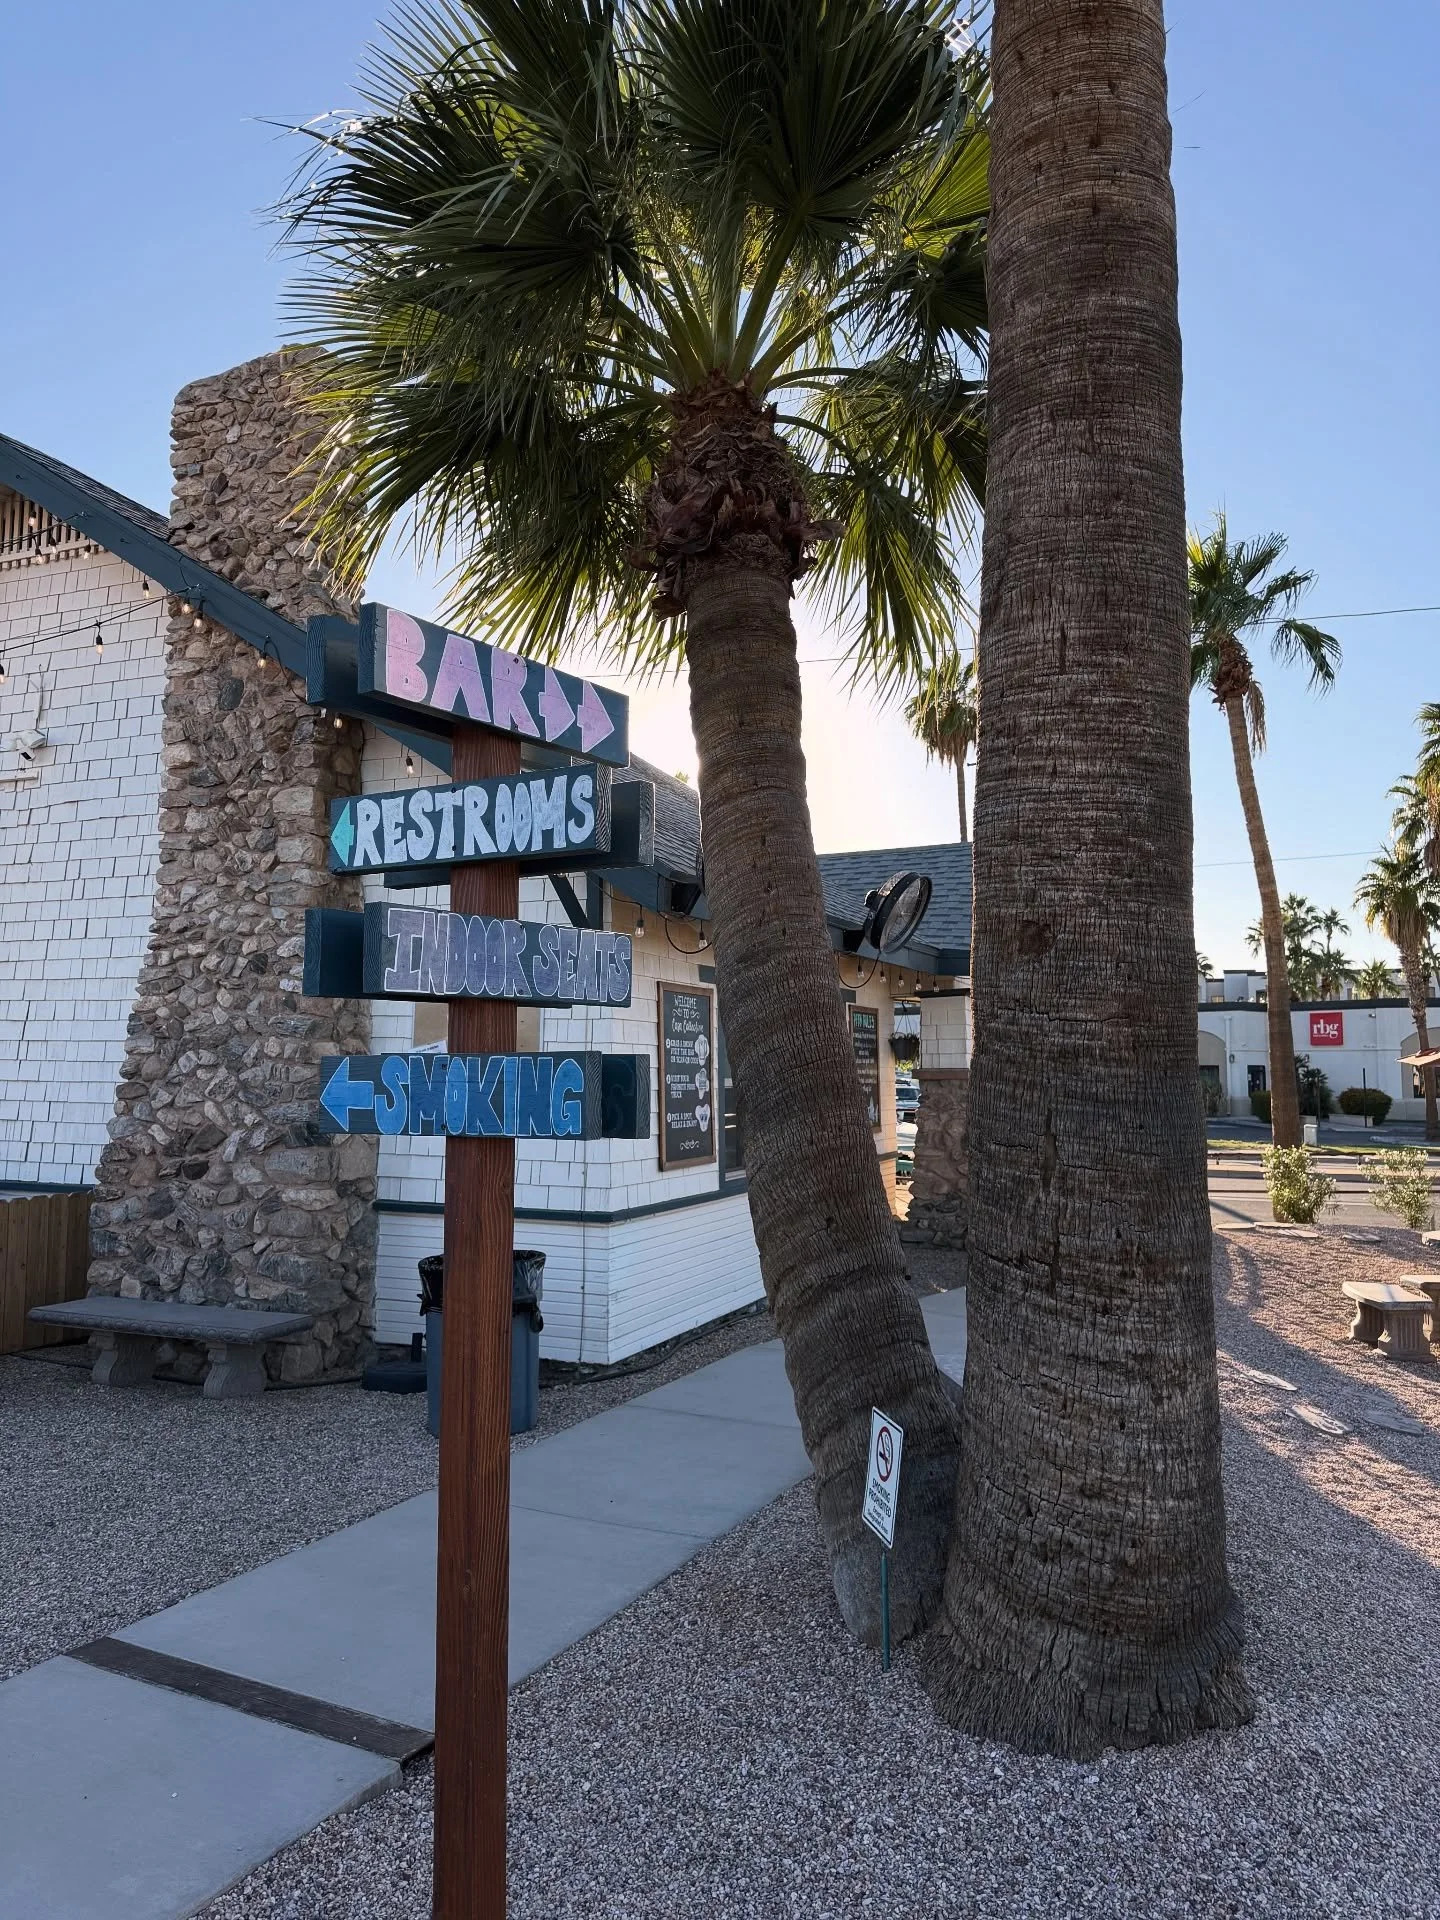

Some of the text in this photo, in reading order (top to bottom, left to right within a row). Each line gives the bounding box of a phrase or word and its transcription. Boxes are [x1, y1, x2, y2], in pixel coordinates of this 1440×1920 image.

[385, 607, 541, 738] BAR
[354, 773, 595, 867] RESTROOMS
[384, 907, 632, 1003] INDOOR SEATS
[674, 995, 697, 1009] WELCOME
[1312, 1019, 1339, 1039] rbg
[374, 1055, 584, 1137] SMOKING
